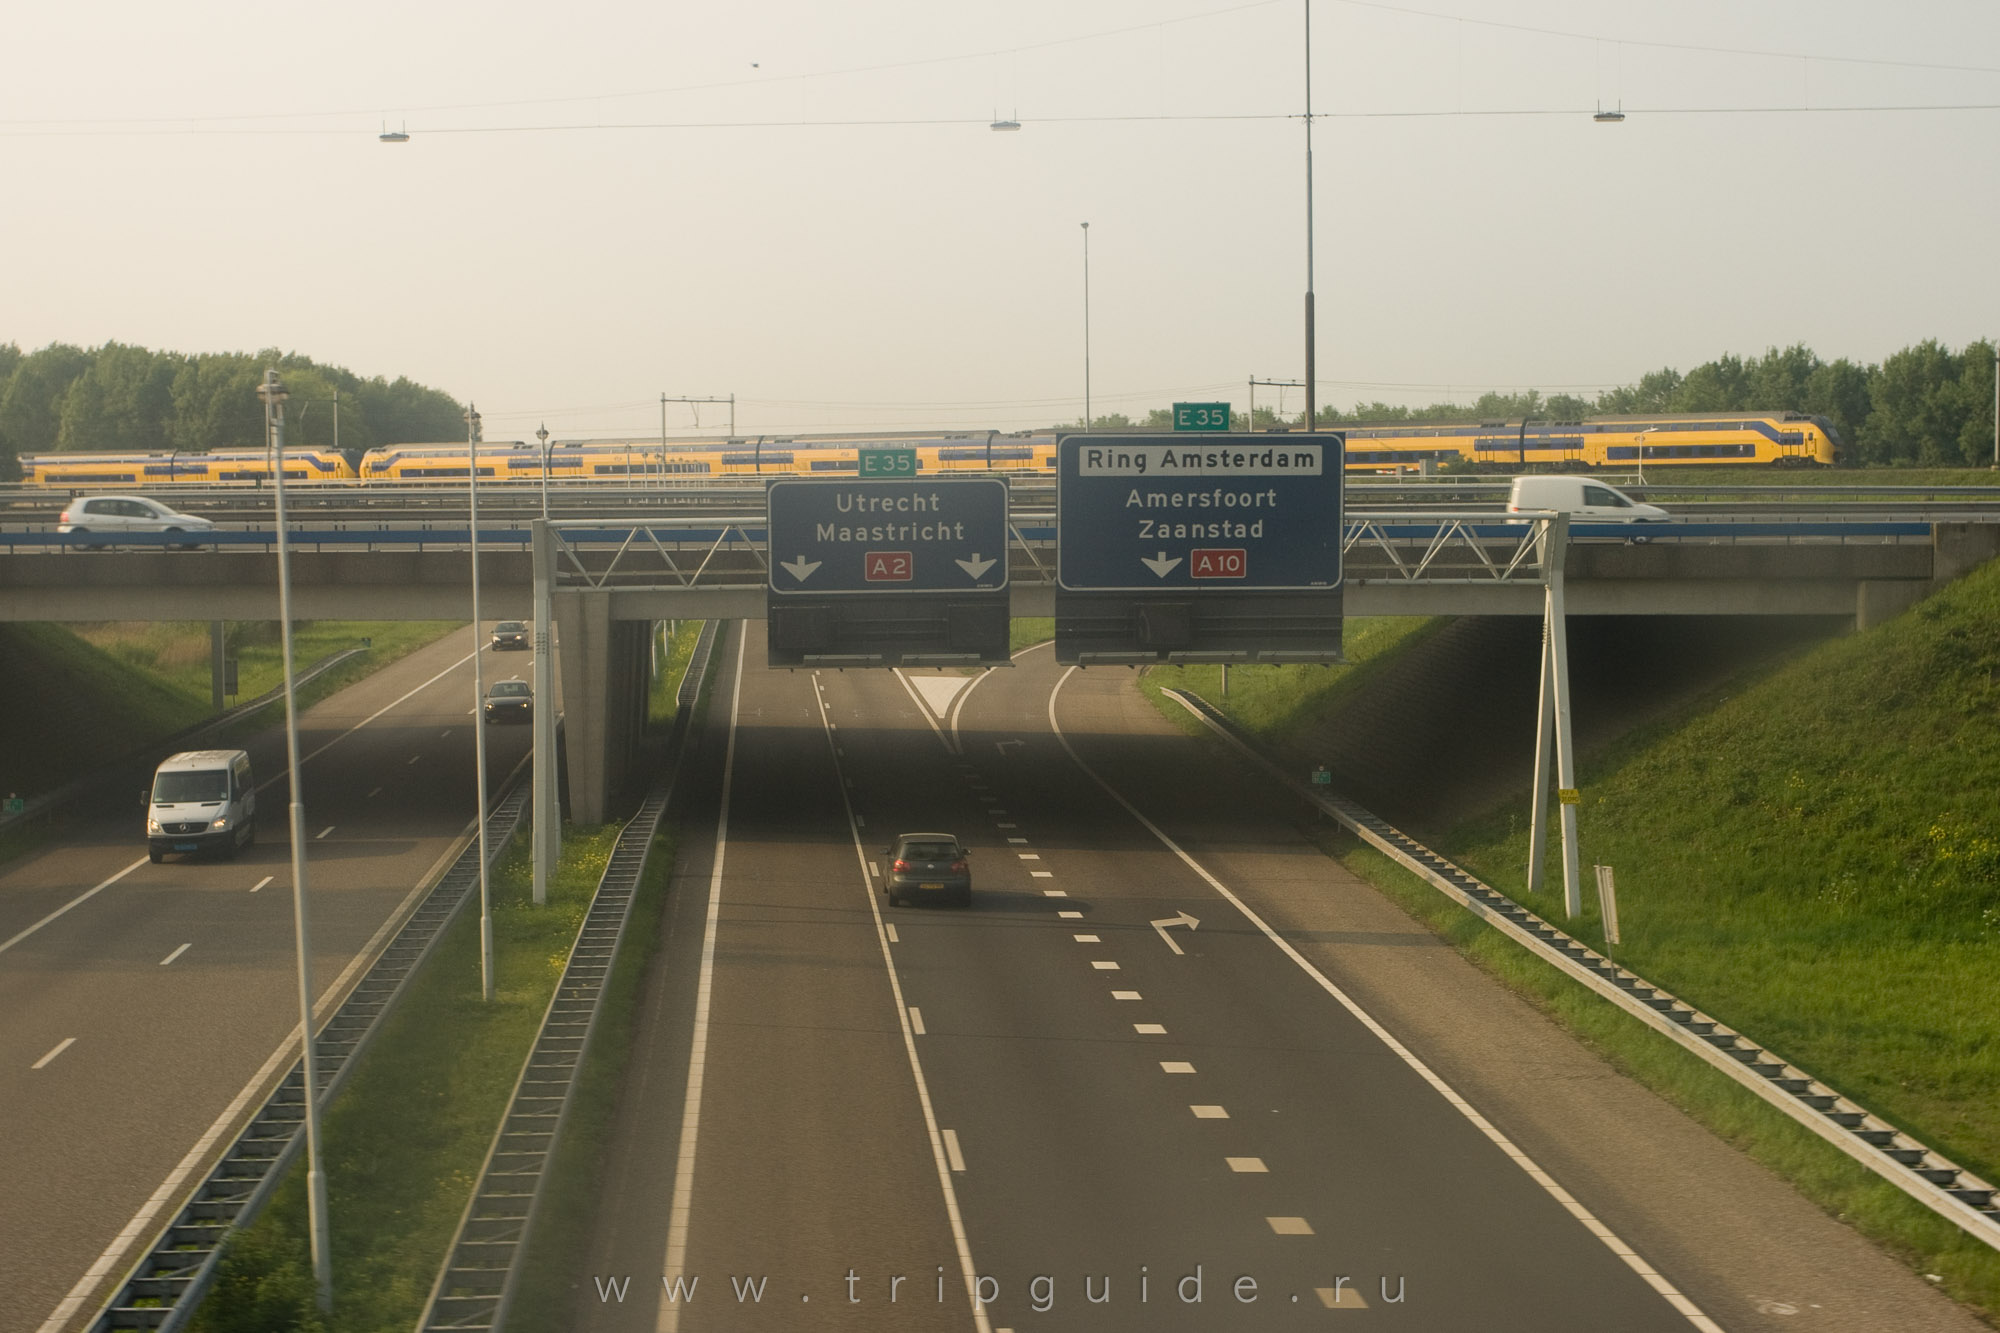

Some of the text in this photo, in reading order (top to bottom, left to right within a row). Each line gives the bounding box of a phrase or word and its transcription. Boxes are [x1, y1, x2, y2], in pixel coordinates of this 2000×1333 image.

[1087, 448, 1314, 474] Ring Amsterdam
[836, 492, 940, 513] Utrecht
[1125, 488, 1277, 508] Amersfoort
[816, 521, 964, 542] Maastricht
[1138, 519, 1263, 539] Zaanstad
